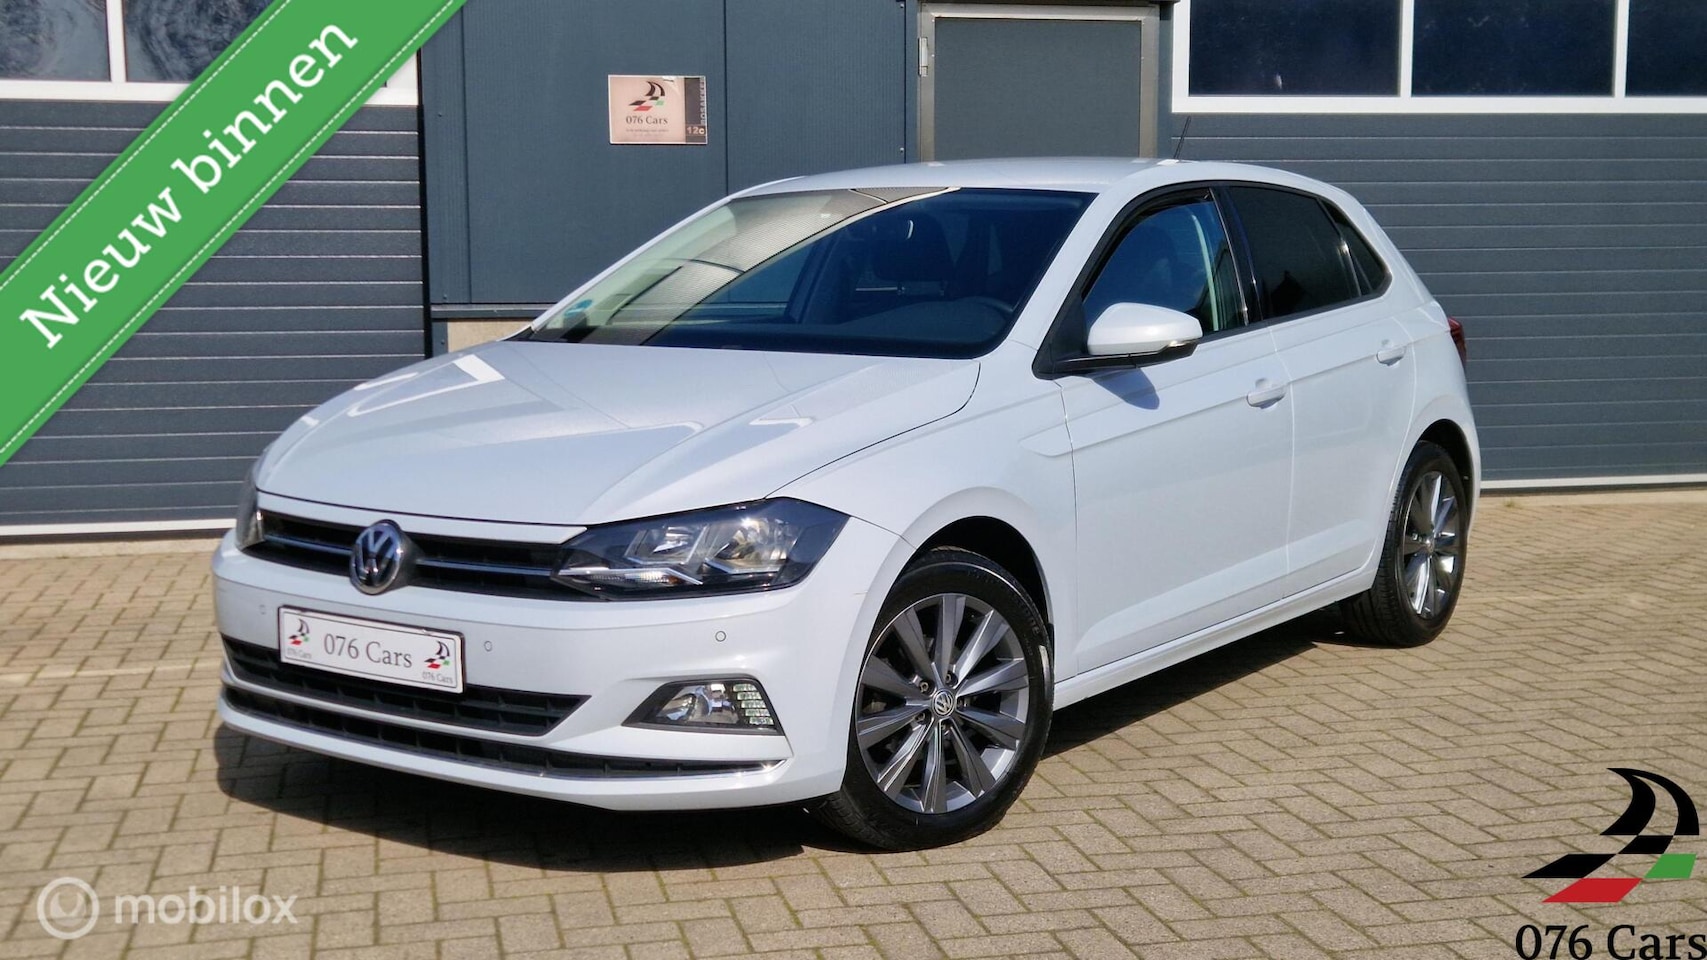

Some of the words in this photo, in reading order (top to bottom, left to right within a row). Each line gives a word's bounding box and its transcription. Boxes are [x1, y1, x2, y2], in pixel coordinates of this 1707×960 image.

[625, 115, 643, 125] 076
[645, 115, 668, 125] Cars
[686, 126, 705, 135] 12c
[323, 633, 359, 659] 076
[365, 641, 413, 668] Cars
[422, 671, 435, 681] 076
[436, 673, 453, 685] Cars
